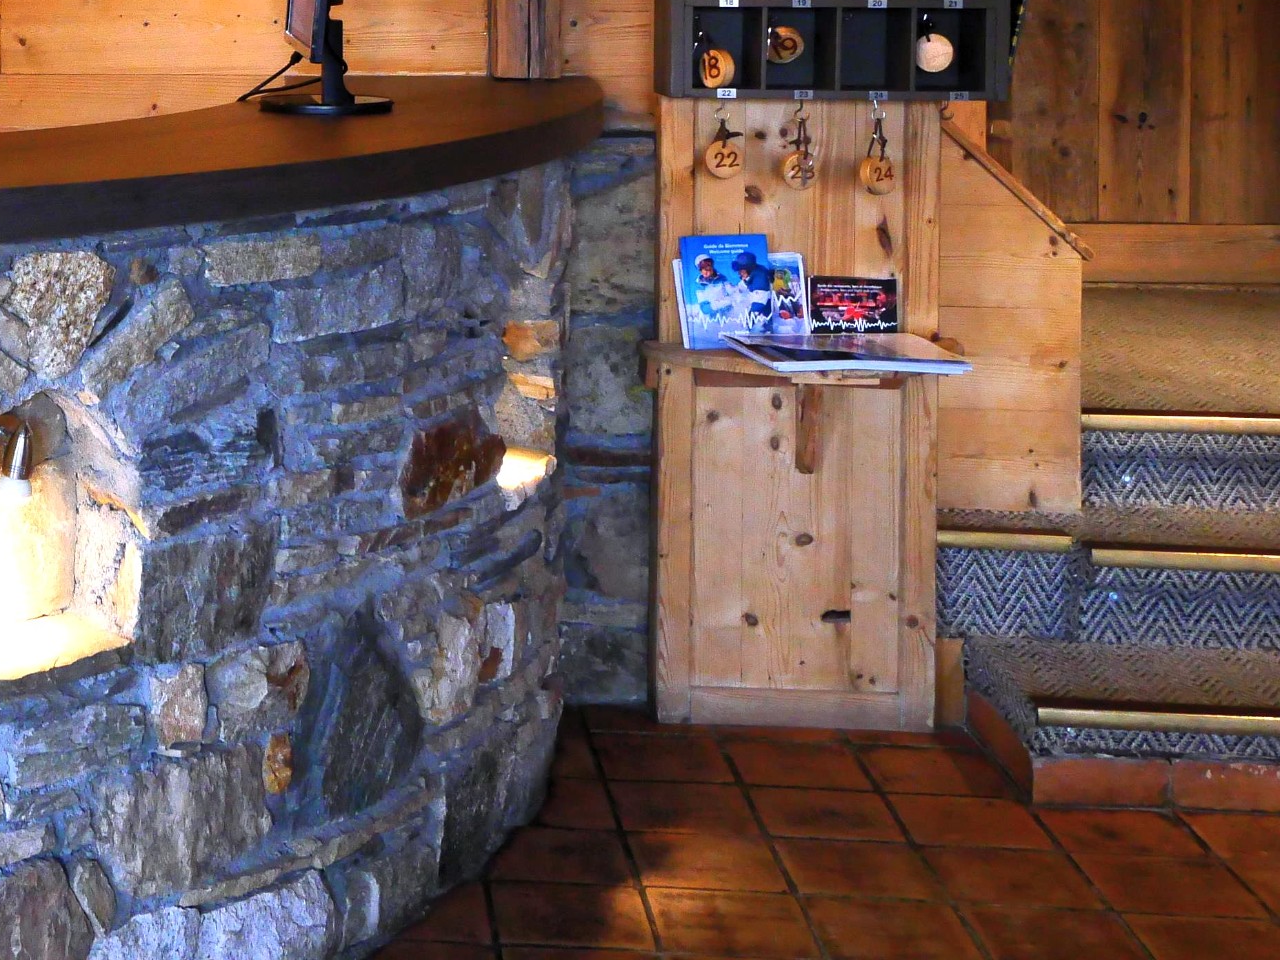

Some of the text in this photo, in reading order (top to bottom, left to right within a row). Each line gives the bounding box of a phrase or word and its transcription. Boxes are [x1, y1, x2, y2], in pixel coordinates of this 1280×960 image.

[703, 55, 720, 81] 18
[714, 152, 740, 168] 22
[874, 166, 894, 182] 24
